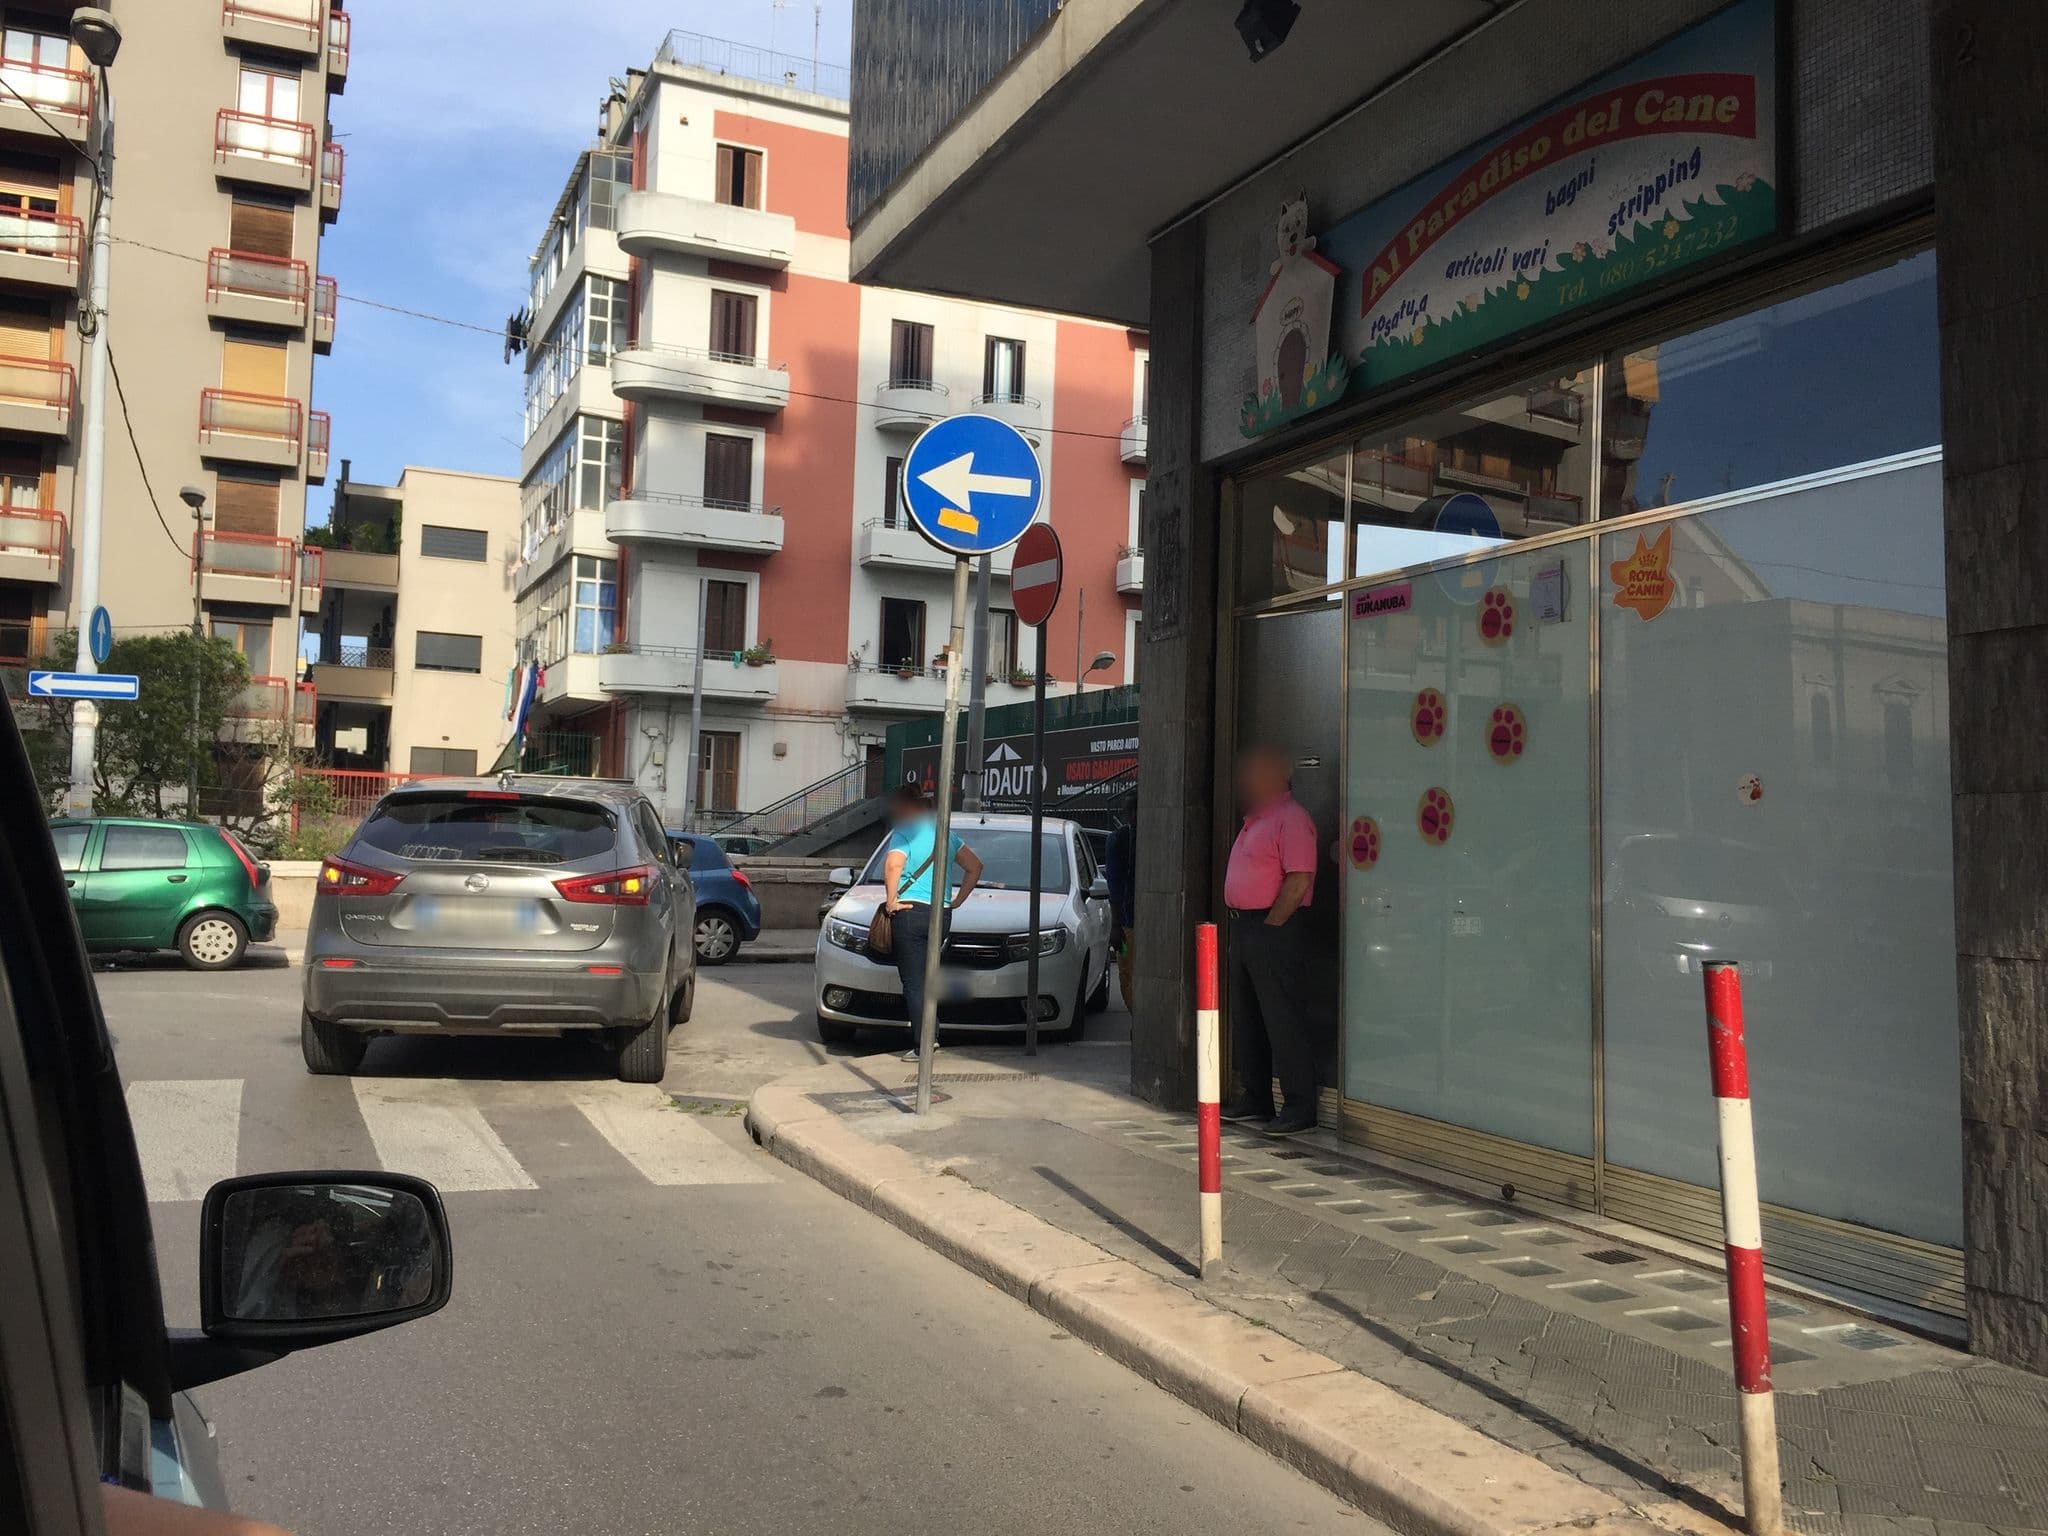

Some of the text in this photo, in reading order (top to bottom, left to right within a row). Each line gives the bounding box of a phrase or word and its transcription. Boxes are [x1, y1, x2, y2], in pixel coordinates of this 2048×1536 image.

[1368, 89, 1740, 301] Al Paradiso del Cane
[1545, 157, 1596, 216] bagni
[1606, 145, 1702, 236] stripping
[1445, 239, 1549, 279] articoli vari
[1370, 294, 1429, 340] tosatura
[1627, 582, 1665, 597] CANIN
[1629, 569, 1665, 582] ROYAL
[1356, 594, 1406, 616] EUKANUBA
[1125, 737, 1139, 750] AUTO
